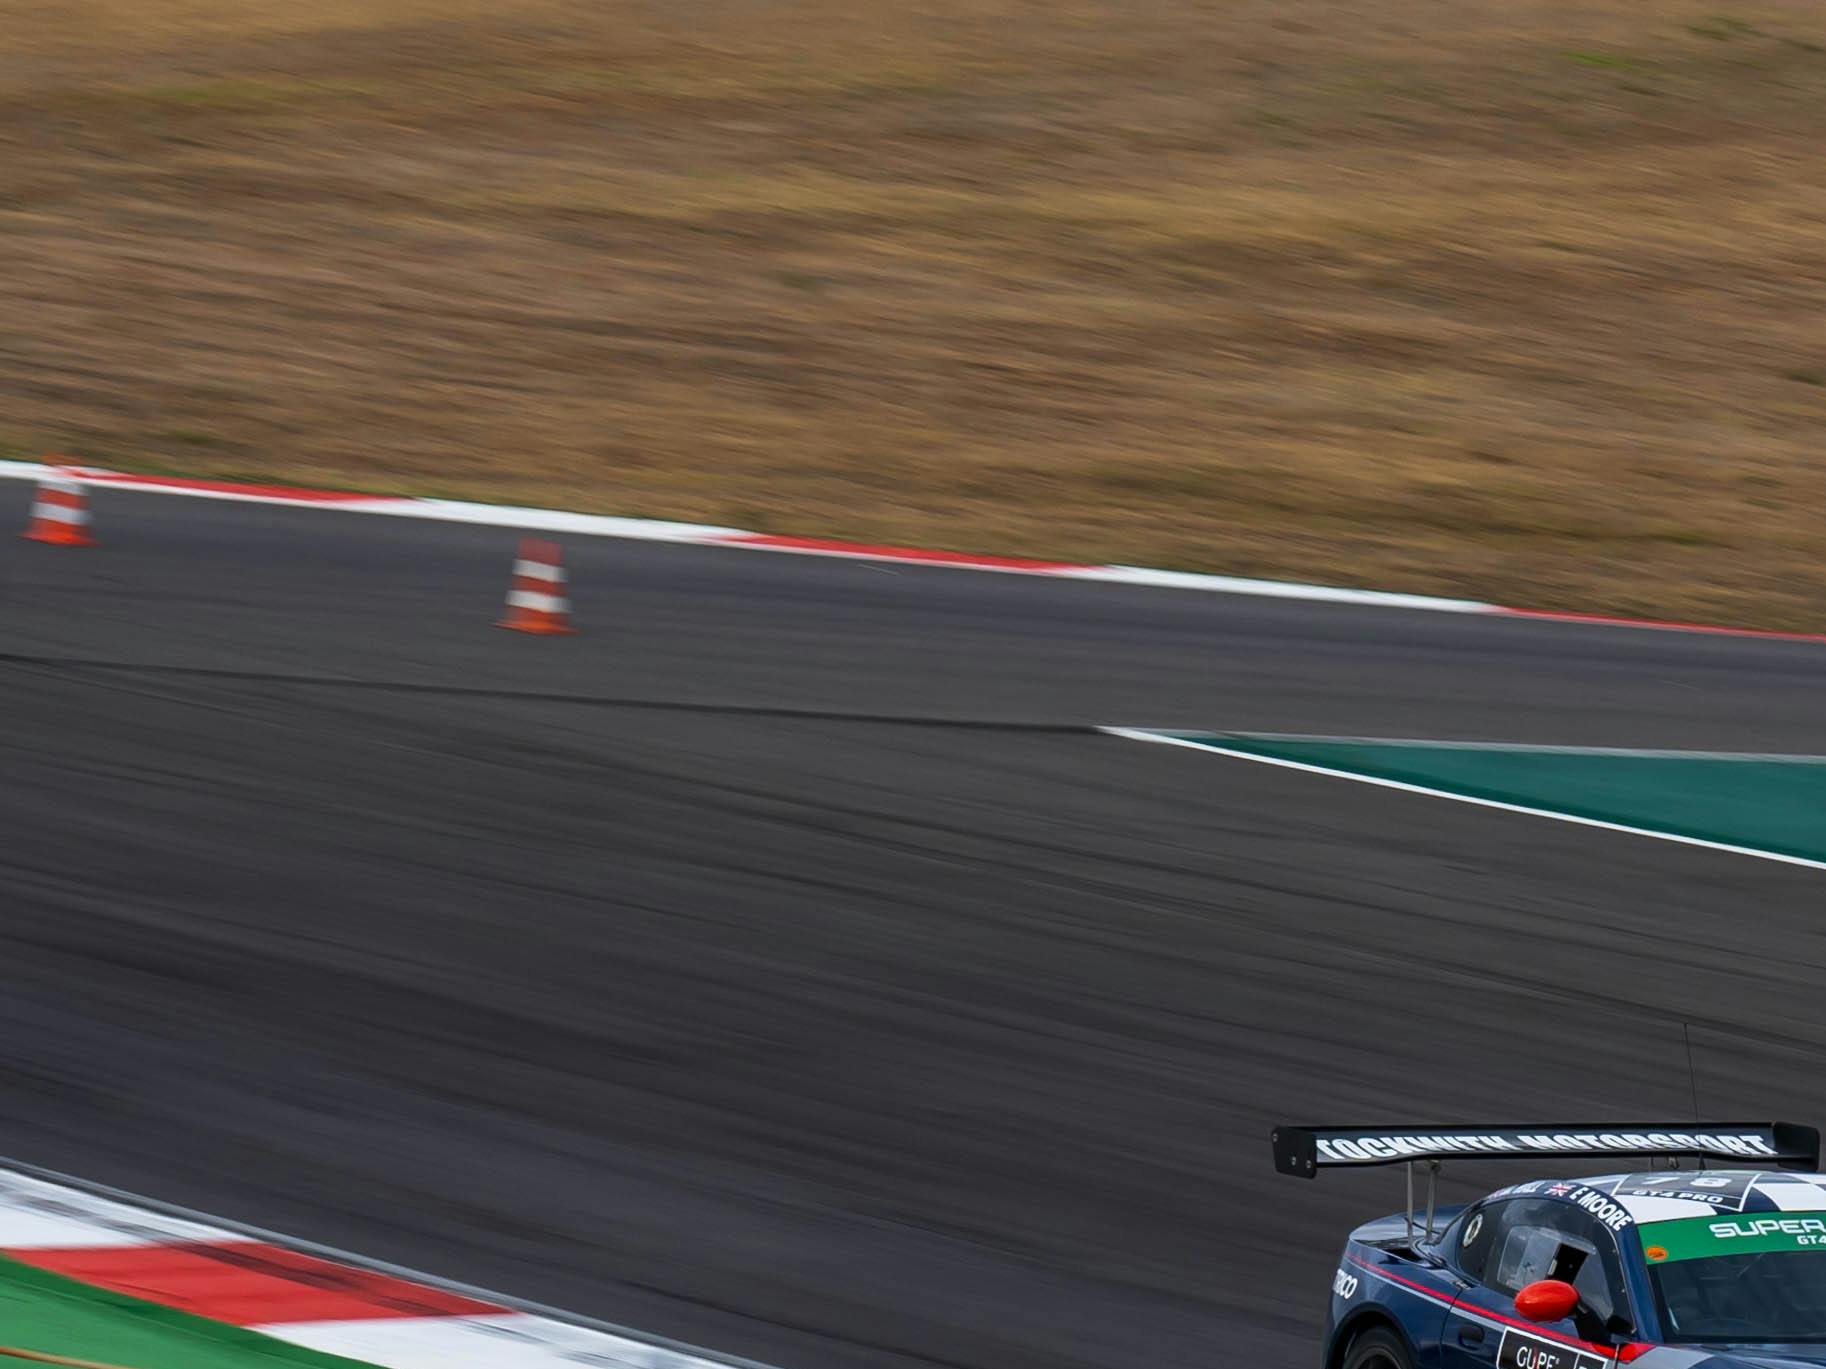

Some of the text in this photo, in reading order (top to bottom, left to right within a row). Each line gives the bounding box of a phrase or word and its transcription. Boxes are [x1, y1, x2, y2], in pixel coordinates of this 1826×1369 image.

[1518, 1134, 1778, 1155] MOTORSPORT
[1569, 1187, 1588, 1200] E
[1677, 1192, 1723, 1204] PRO
[1577, 1193, 1632, 1232] MOORE
